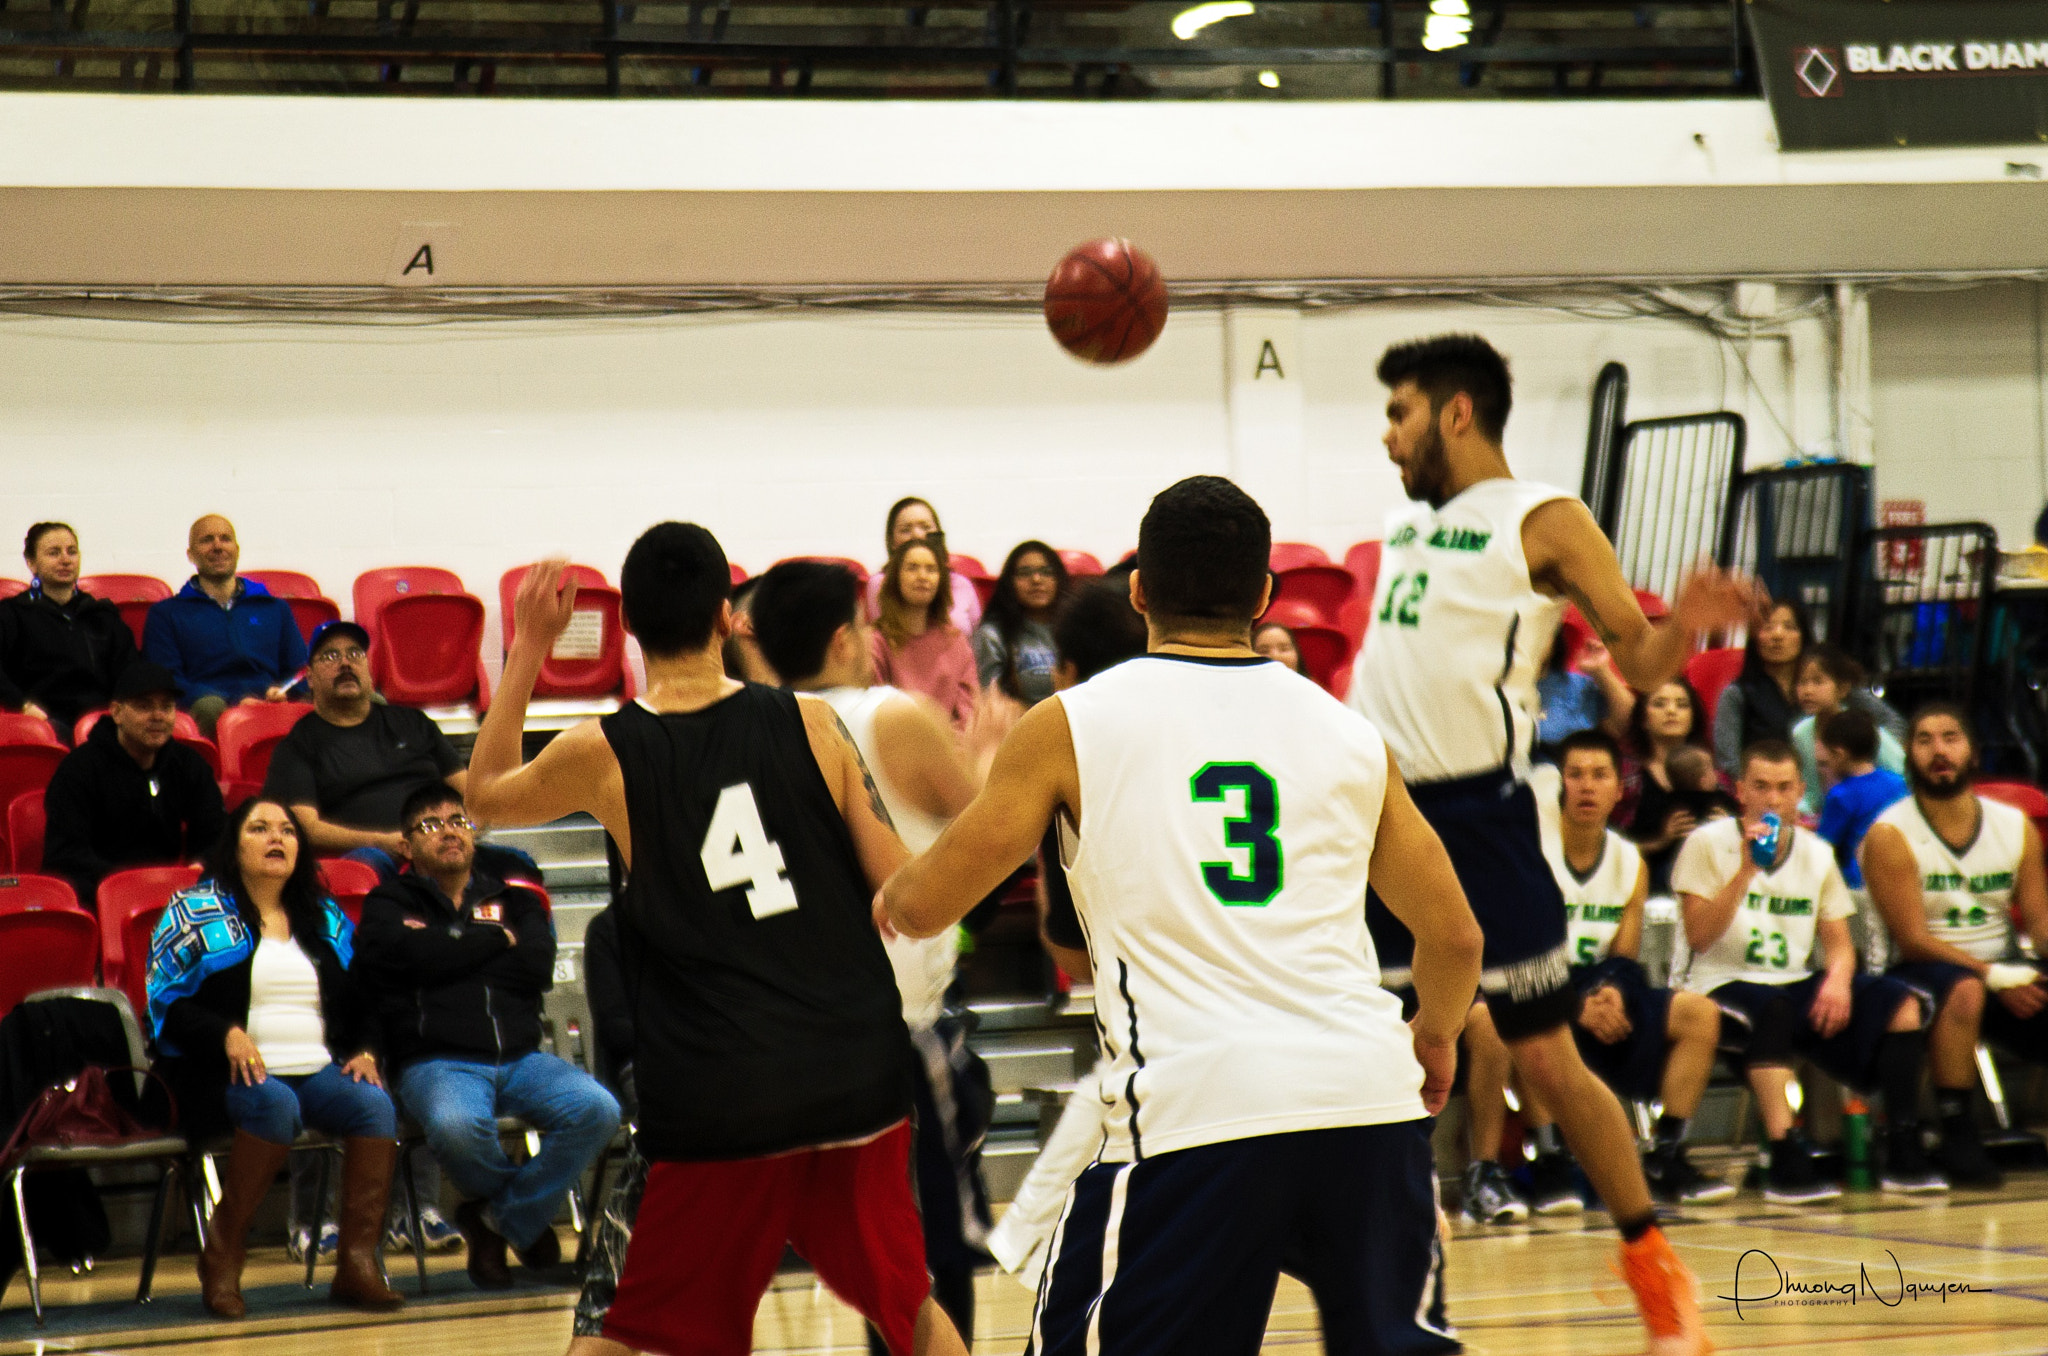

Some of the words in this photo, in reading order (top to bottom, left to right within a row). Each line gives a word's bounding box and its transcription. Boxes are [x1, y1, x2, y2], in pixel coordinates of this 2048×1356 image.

[1846, 43, 1958, 72] BLACK
[1963, 42, 2048, 70] DIAM
[402, 244, 434, 275] A
[1255, 339, 1285, 379] A
[1380, 571, 1428, 626] 12
[700, 781, 799, 921] 4
[1189, 761, 1284, 907] 3
[1576, 936, 1598, 967] 5
[1745, 928, 1789, 968] 23
